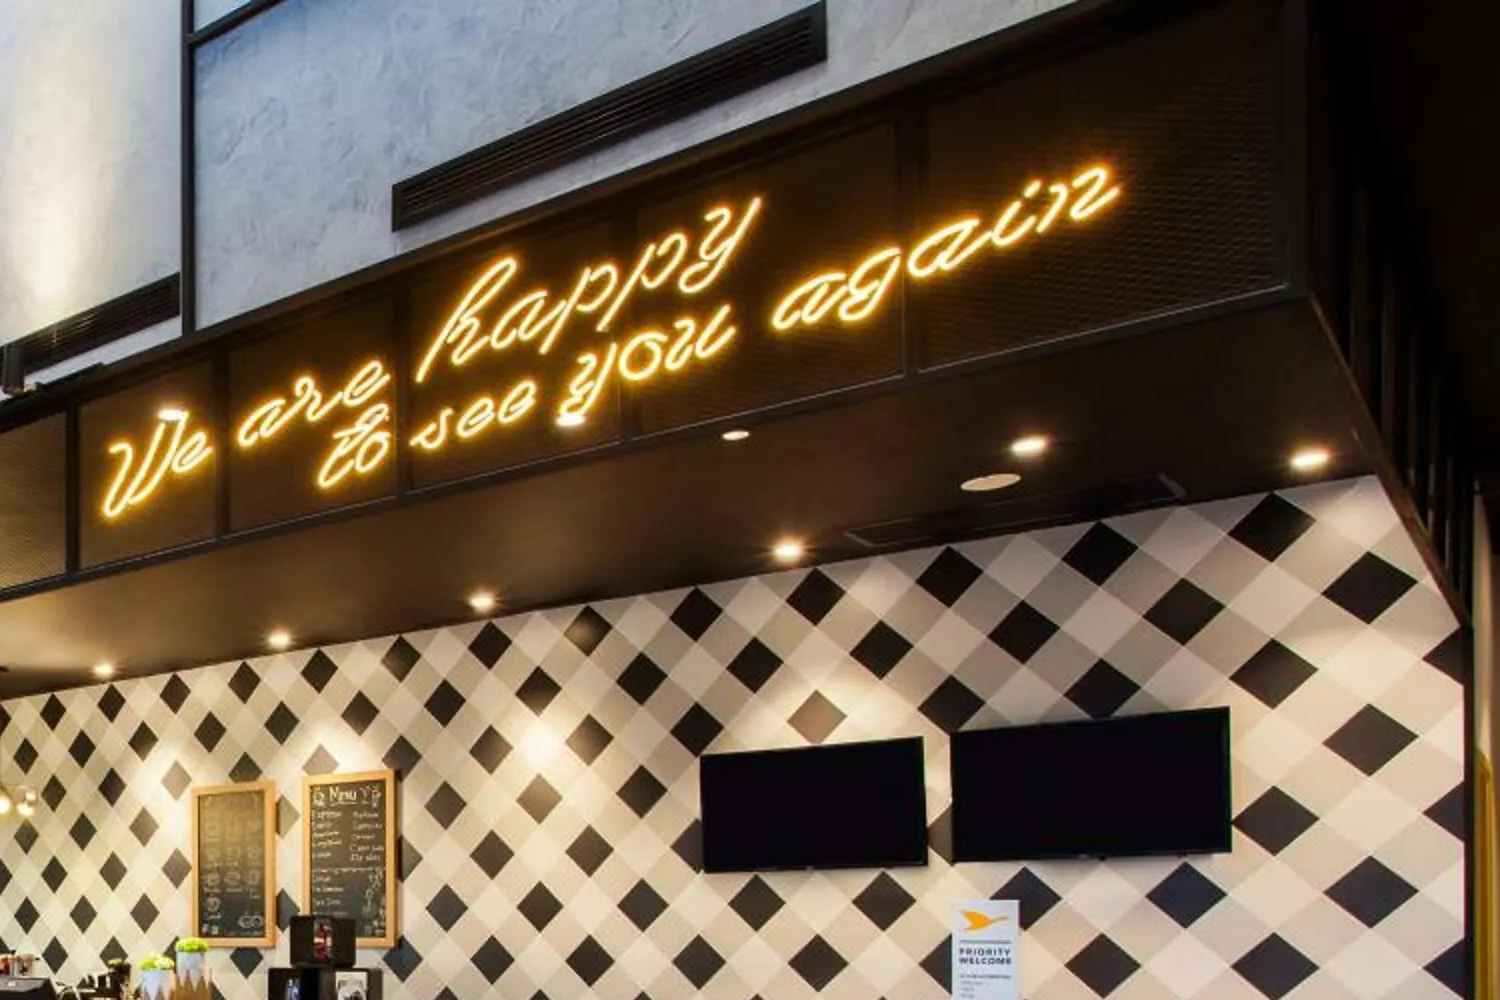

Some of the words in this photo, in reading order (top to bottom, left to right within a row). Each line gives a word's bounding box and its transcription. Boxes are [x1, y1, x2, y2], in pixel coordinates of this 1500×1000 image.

[102, 408, 214, 519] We
[236, 360, 392, 447] are
[415, 196, 762, 383] happy
[316, 403, 391, 489] to
[409, 379, 538, 450] see
[555, 303, 737, 427] you
[771, 166, 1121, 331] again
[958, 947, 1011, 956] PRIORITY
[958, 956, 1012, 965] WELCOME
